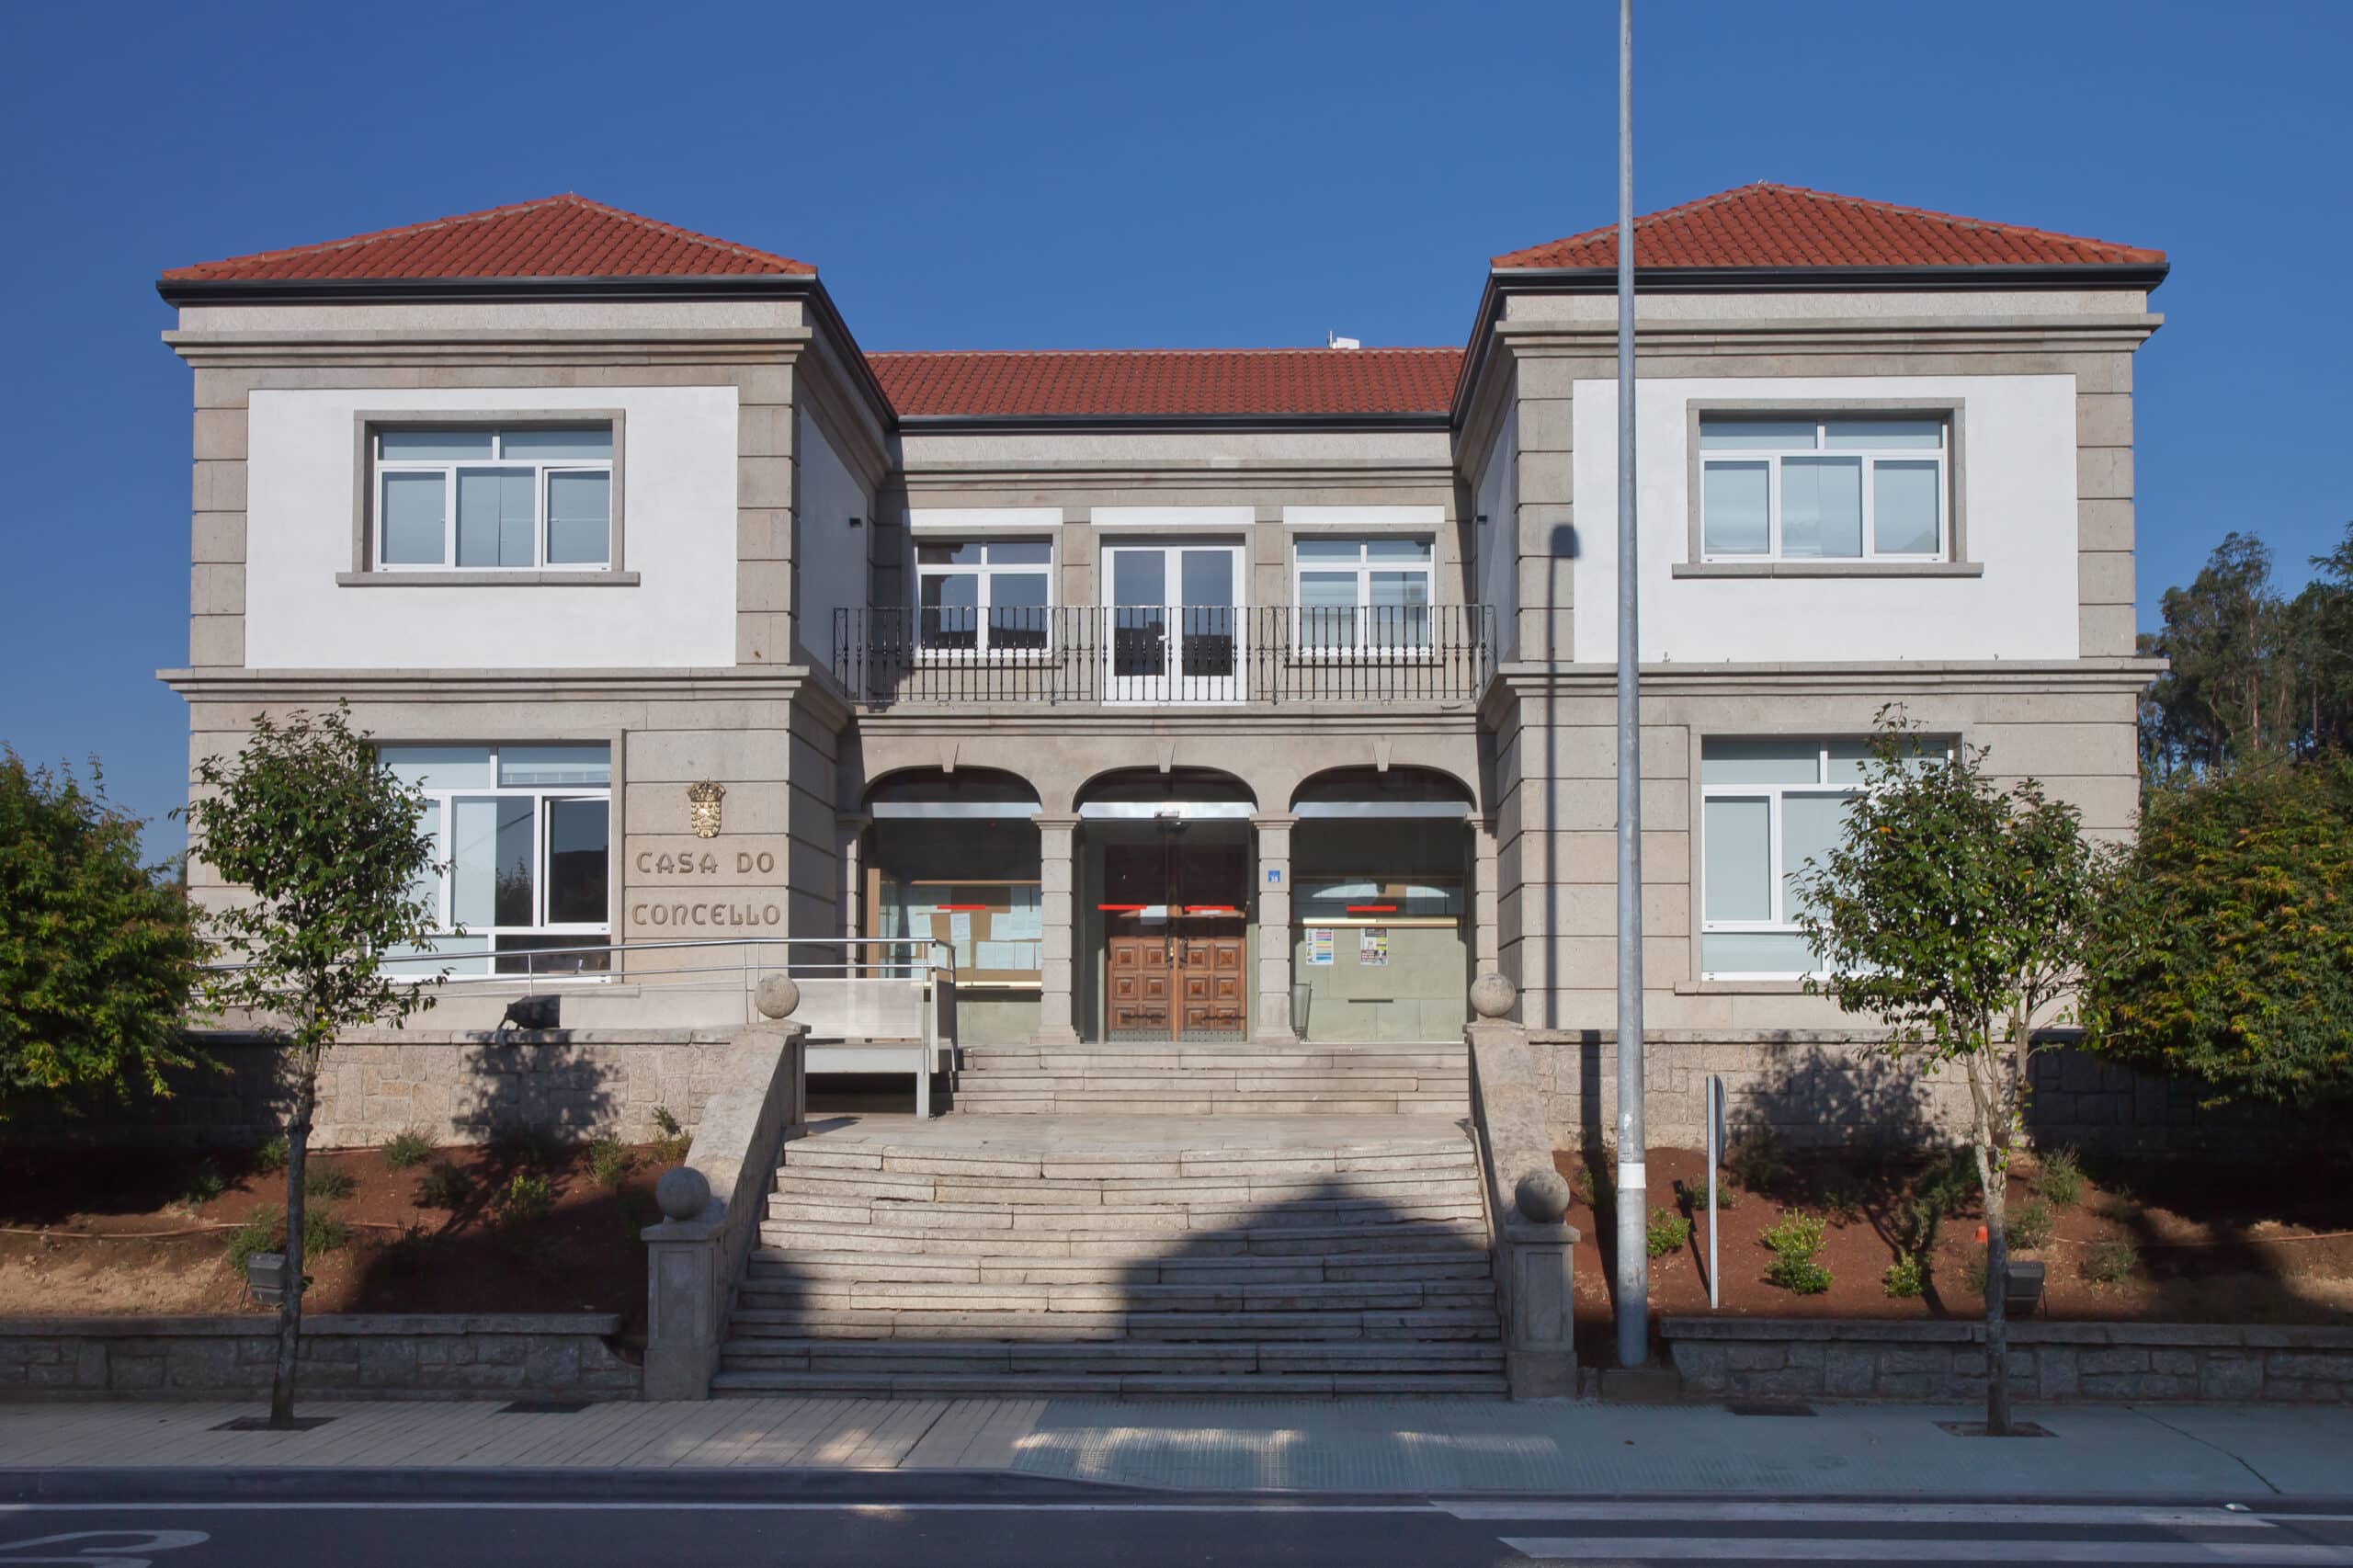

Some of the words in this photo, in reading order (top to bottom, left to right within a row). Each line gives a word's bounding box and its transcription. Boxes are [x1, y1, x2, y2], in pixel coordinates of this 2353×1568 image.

[635, 851, 719, 874] CASA
[736, 851, 775, 874] DO
[631, 903, 781, 926] CONCELLO
